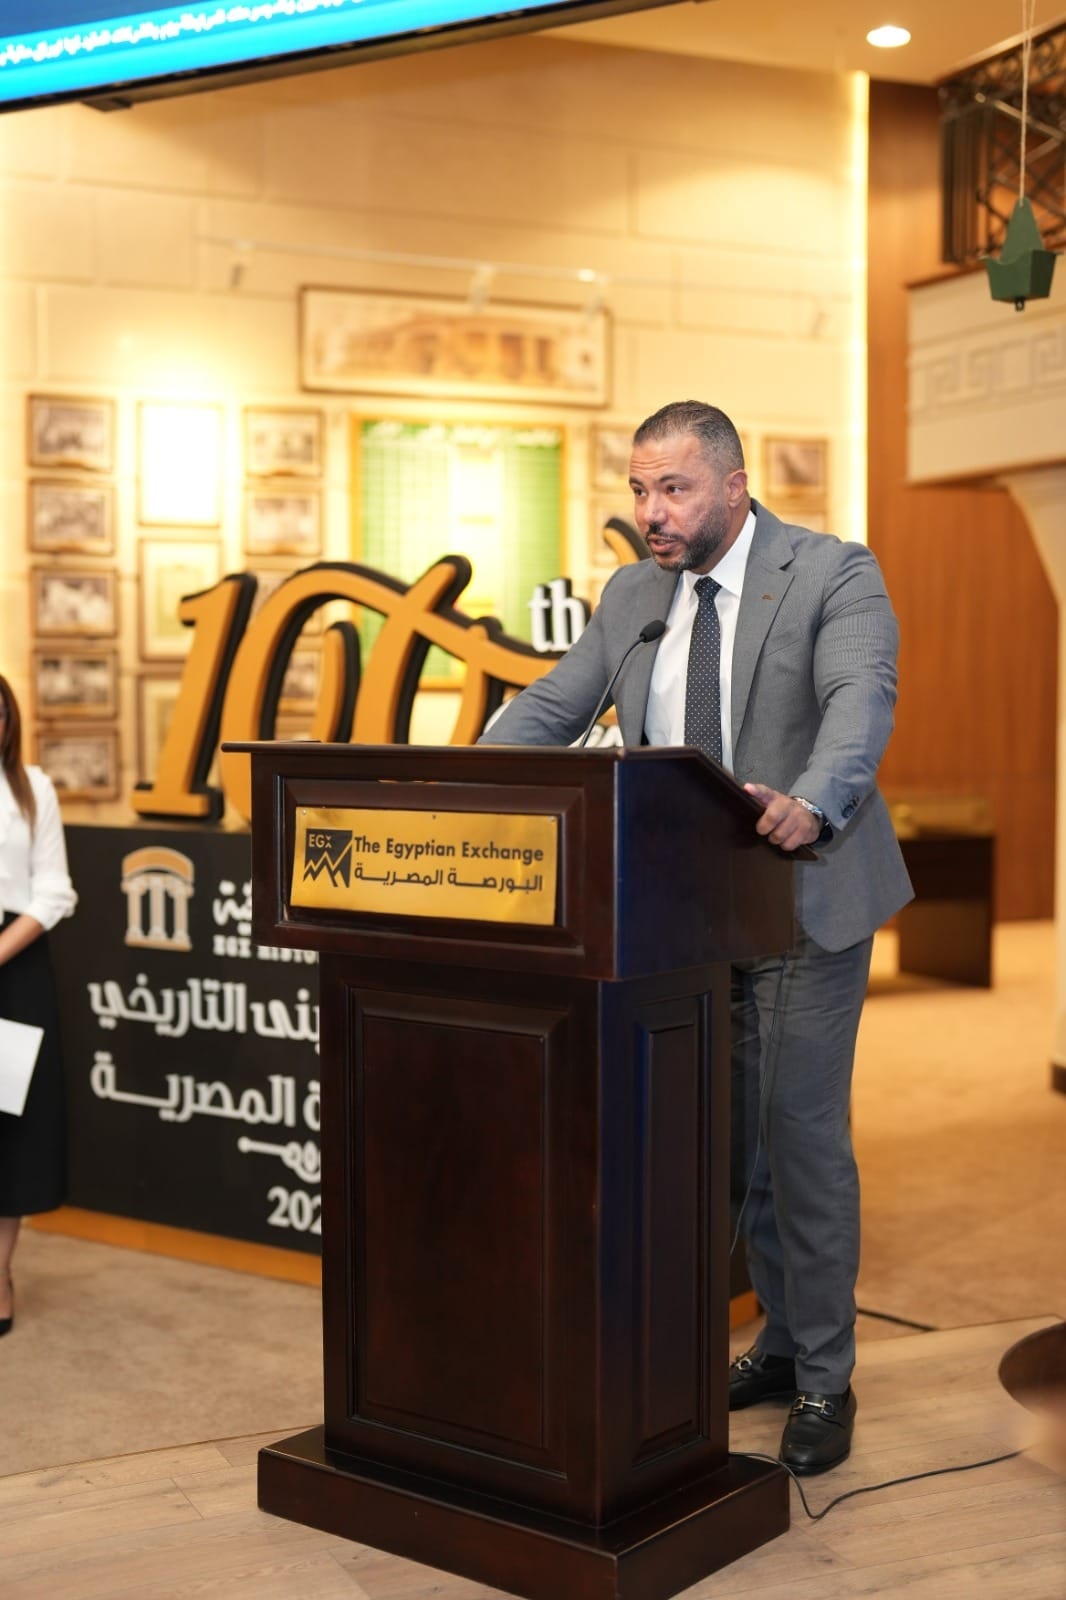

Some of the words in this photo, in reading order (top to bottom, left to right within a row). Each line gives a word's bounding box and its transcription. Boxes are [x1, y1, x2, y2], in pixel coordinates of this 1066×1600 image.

[308, 833, 333, 849] EGX
[354, 836, 380, 854] The
[386, 838, 456, 860] Egyptian
[462, 841, 544, 866] Exchange
[354, 862, 444, 886] المصرية
[447, 868, 543, 894] البورصة
[87, 973, 248, 1038] التاريخي
[90, 1050, 297, 1128] المصرية
